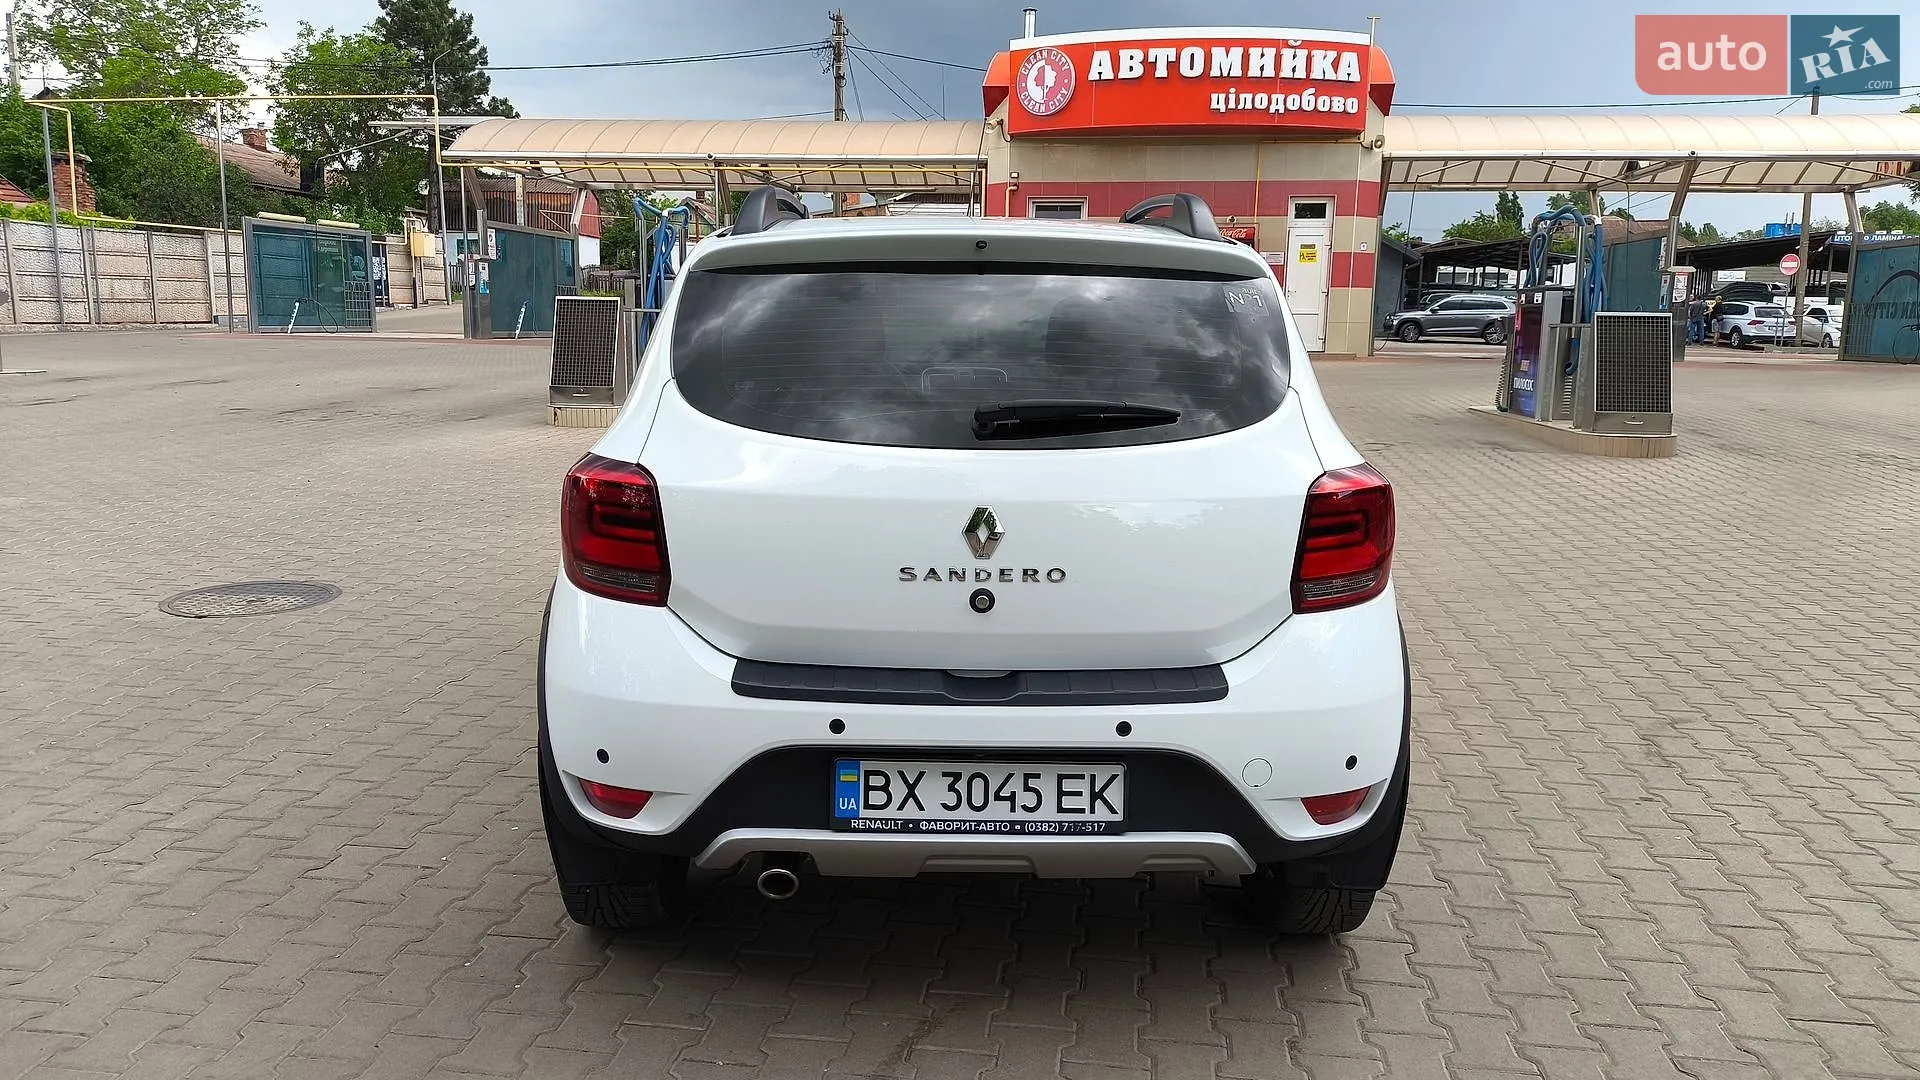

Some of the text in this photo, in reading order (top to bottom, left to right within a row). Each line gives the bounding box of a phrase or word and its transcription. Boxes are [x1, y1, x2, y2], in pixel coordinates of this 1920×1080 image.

[1021, 49, 1070, 75] CLEAN CITY
[1088, 40, 1361, 82] АВТОМИЙКА
[1021, 87, 1068, 113] CLEAN CITY
[1210, 87, 1359, 114] цілодобово
[899, 566, 1067, 583] SANDERO
[839, 797, 857, 810] UA
[863, 769, 1120, 815] BX 3045 EK
[851, 819, 903, 830] RENAULT
[919, 820, 1010, 832] ФАВОРИТ-АВТО
[1025, 822, 1059, 833] (0382)
